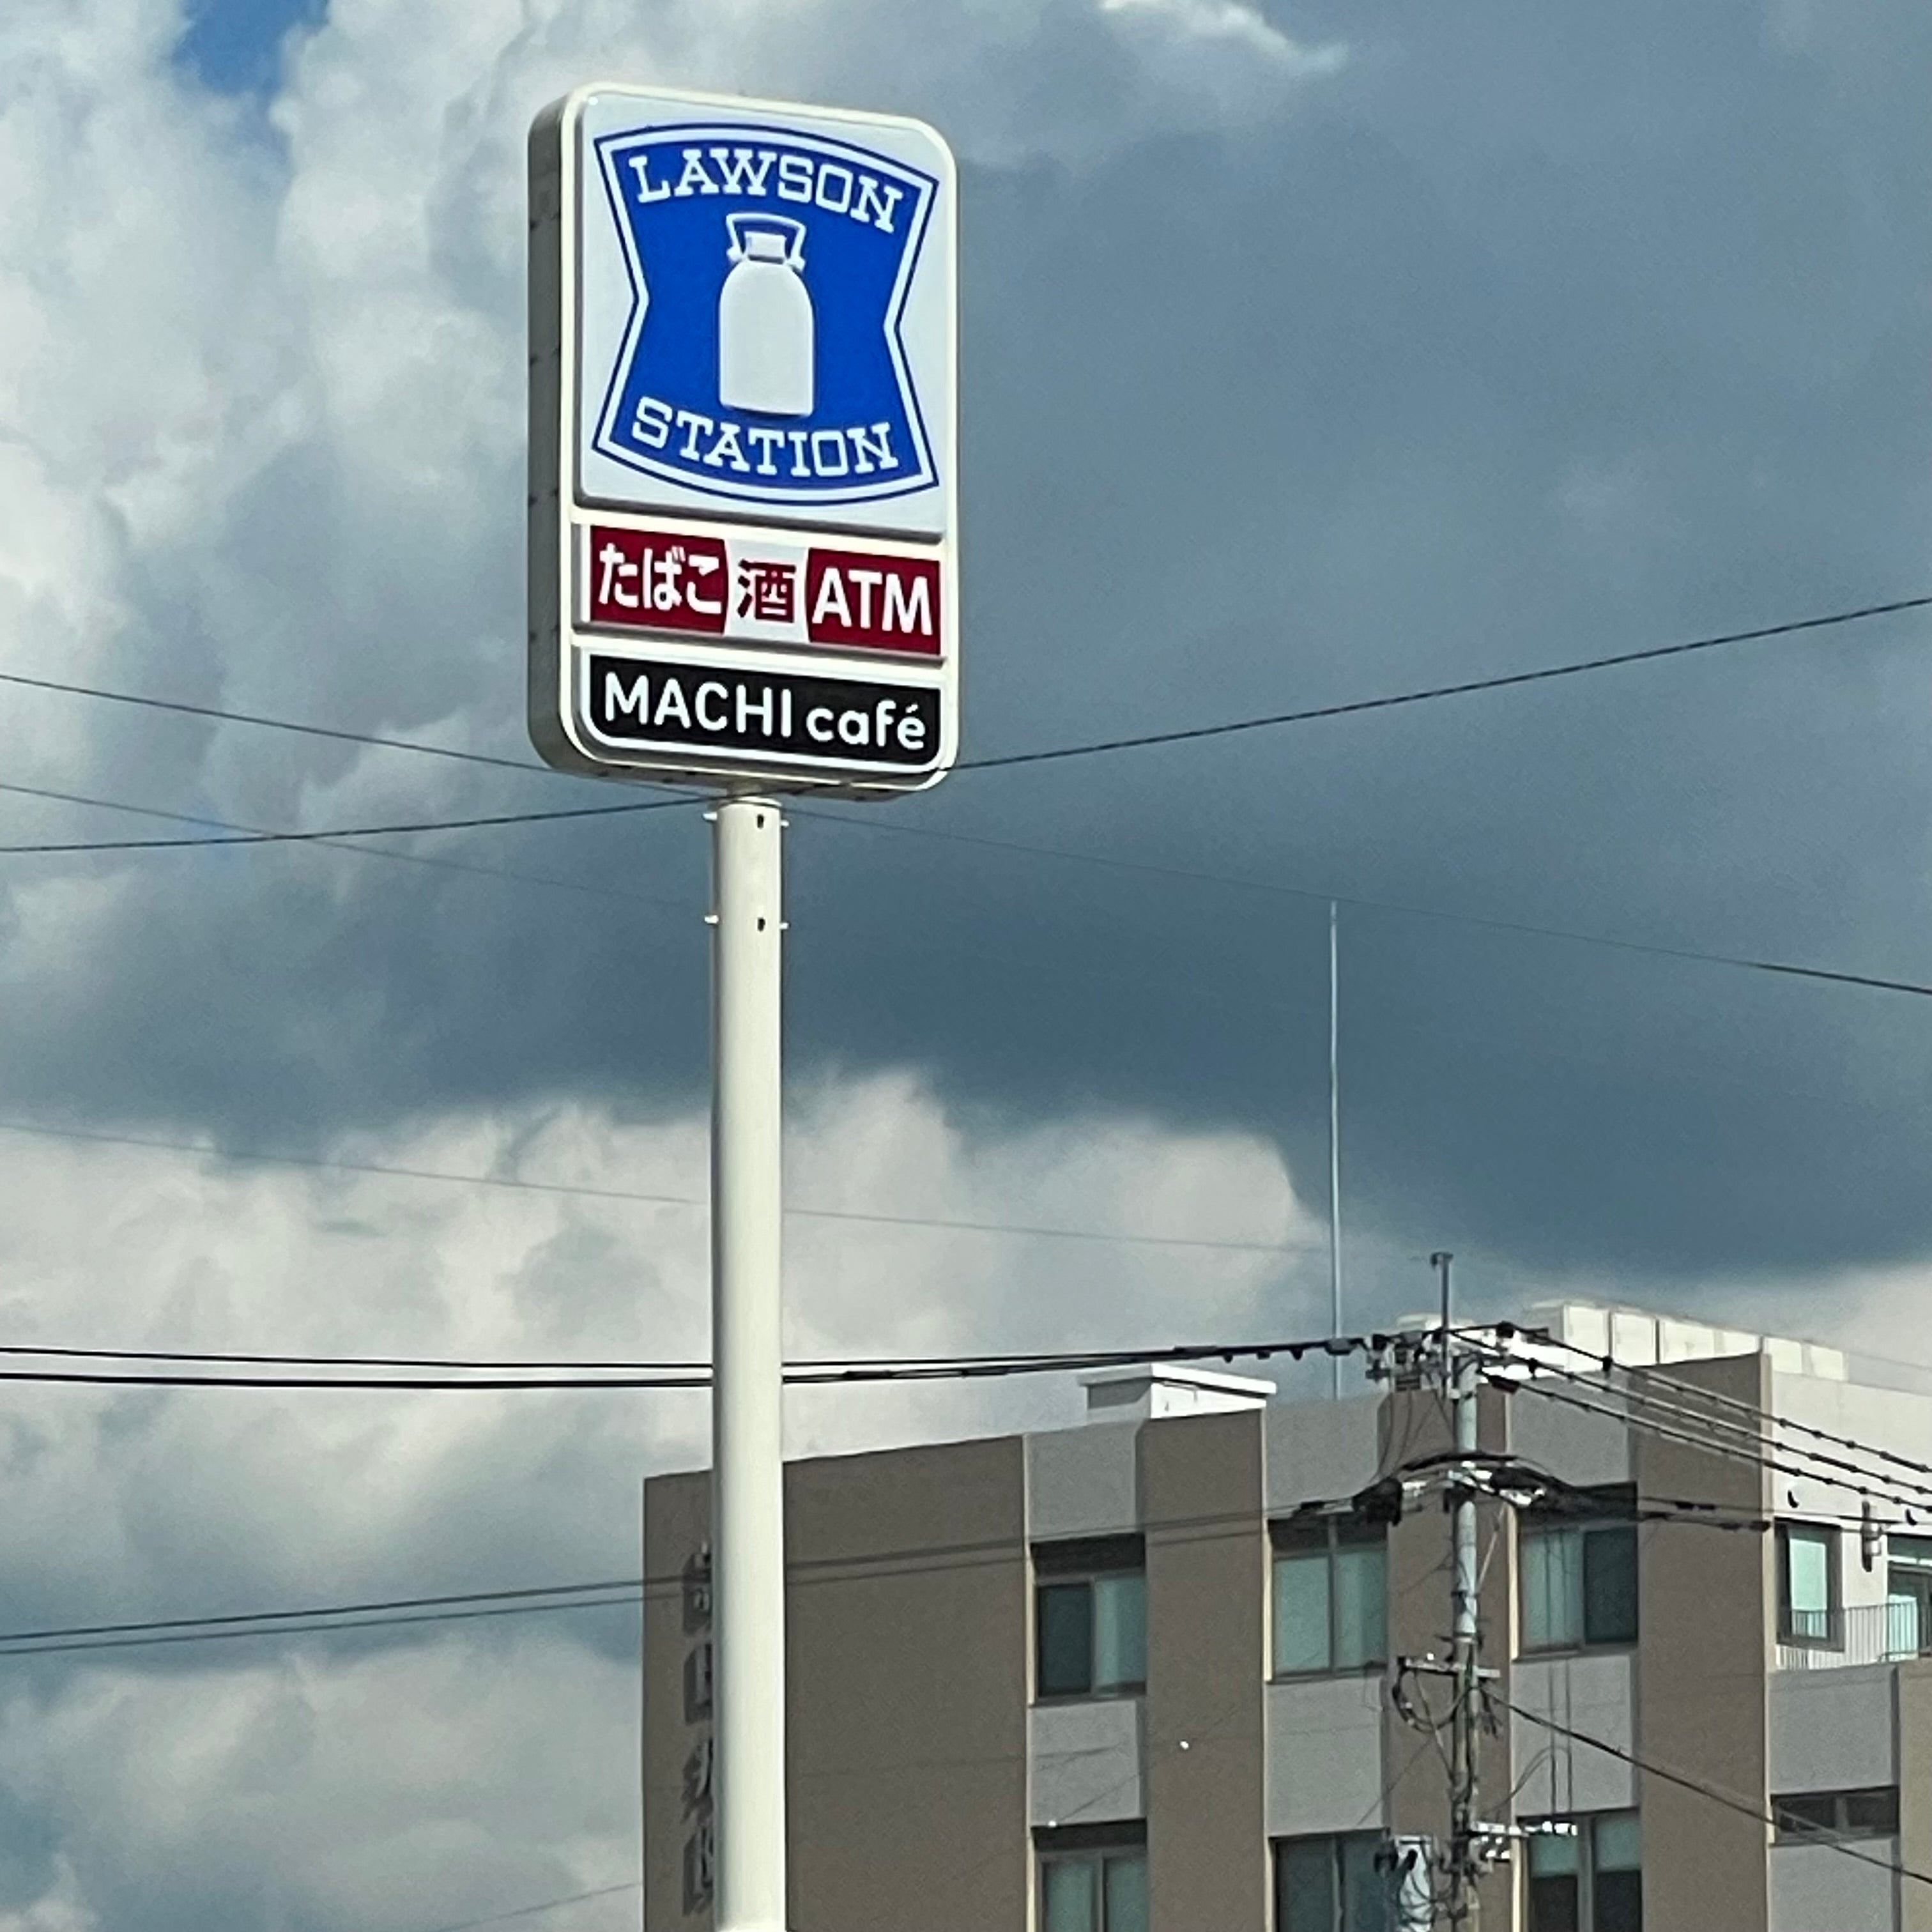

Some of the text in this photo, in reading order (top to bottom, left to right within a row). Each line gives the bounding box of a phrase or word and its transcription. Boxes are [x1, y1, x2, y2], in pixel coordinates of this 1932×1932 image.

[629, 148, 903, 233] LAWSON
[631, 396, 899, 477] STATION
[599, 542, 933, 636] たばこ 酒 ATM
[604, 671, 926, 750] MACHI café
